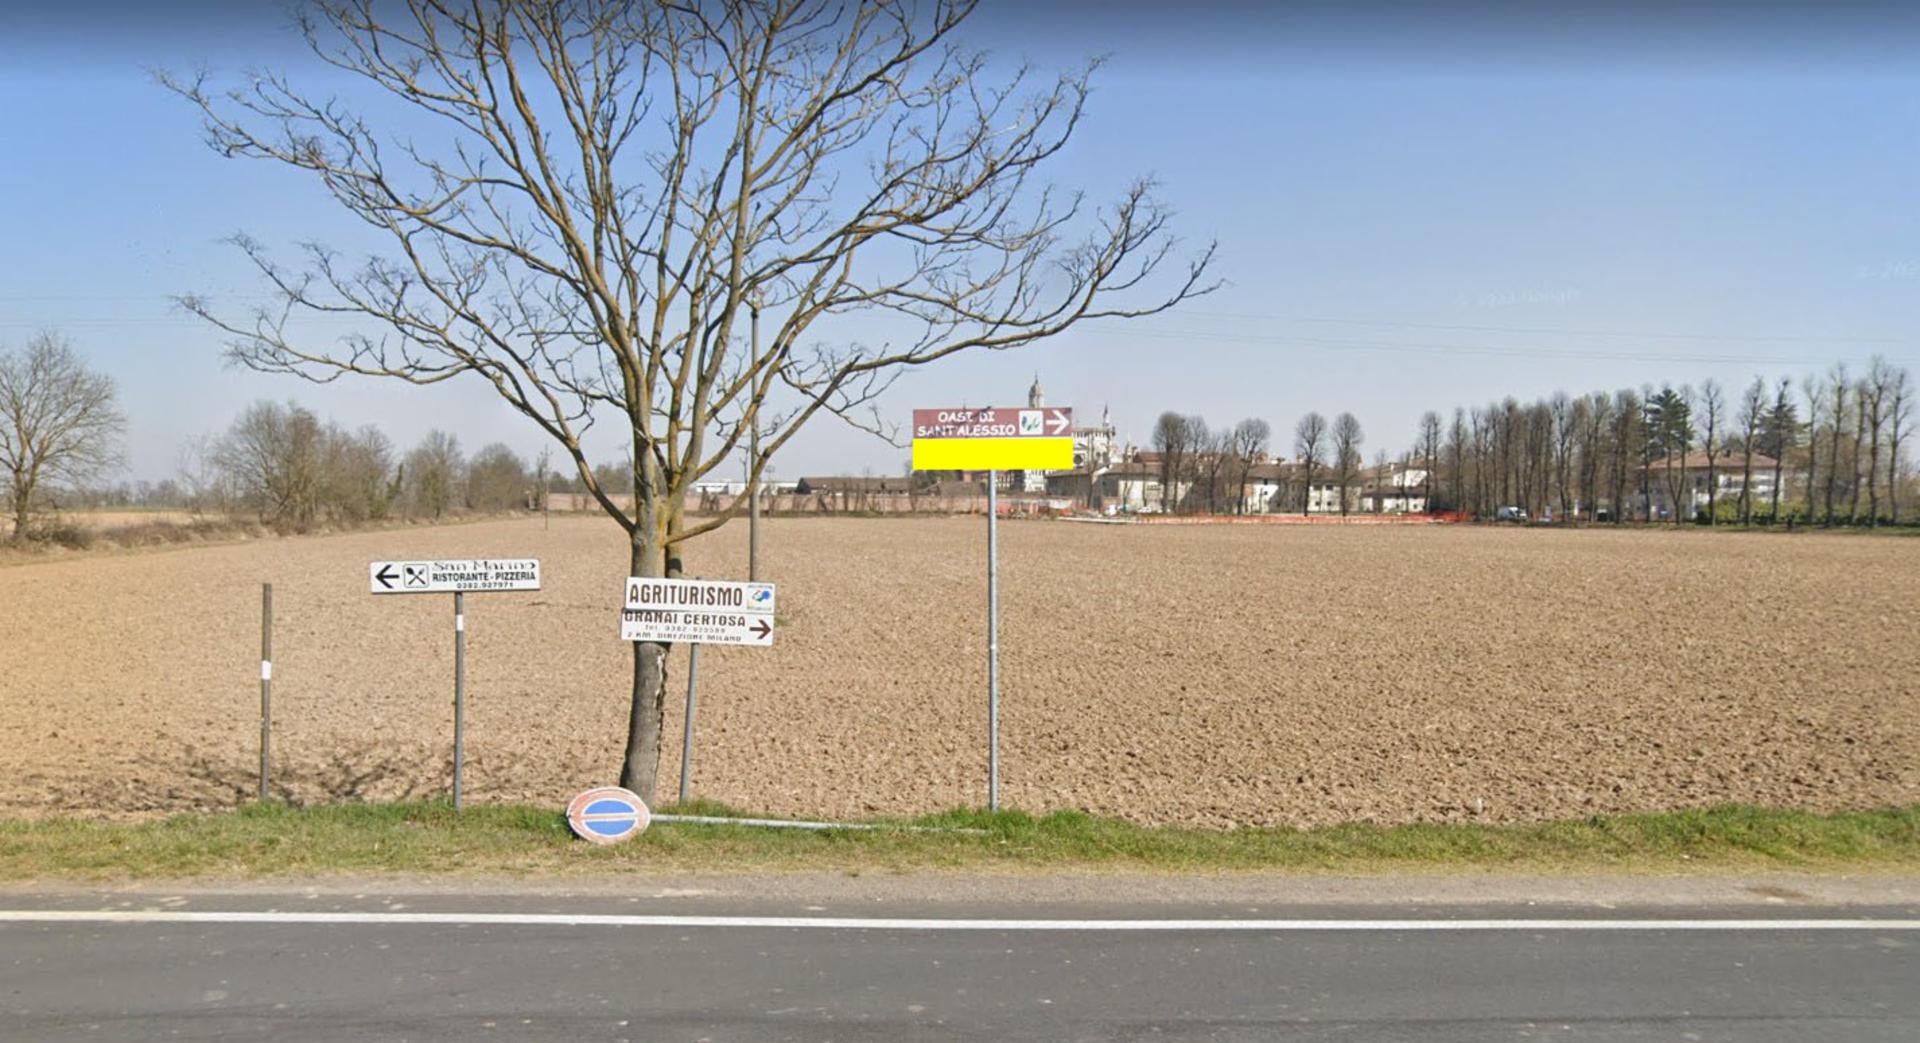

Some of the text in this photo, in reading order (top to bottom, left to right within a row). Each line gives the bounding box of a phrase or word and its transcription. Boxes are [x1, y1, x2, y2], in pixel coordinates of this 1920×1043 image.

[938, 411, 995, 423] OASI DI
[432, 560, 536, 571] San Marino
[432, 572, 489, 582] RISTORANTE
[495, 571, 536, 581] PIZZERIA
[630, 584, 743, 606] AGRITURISMO
[624, 611, 746, 627] GRANAI CERTOSA
